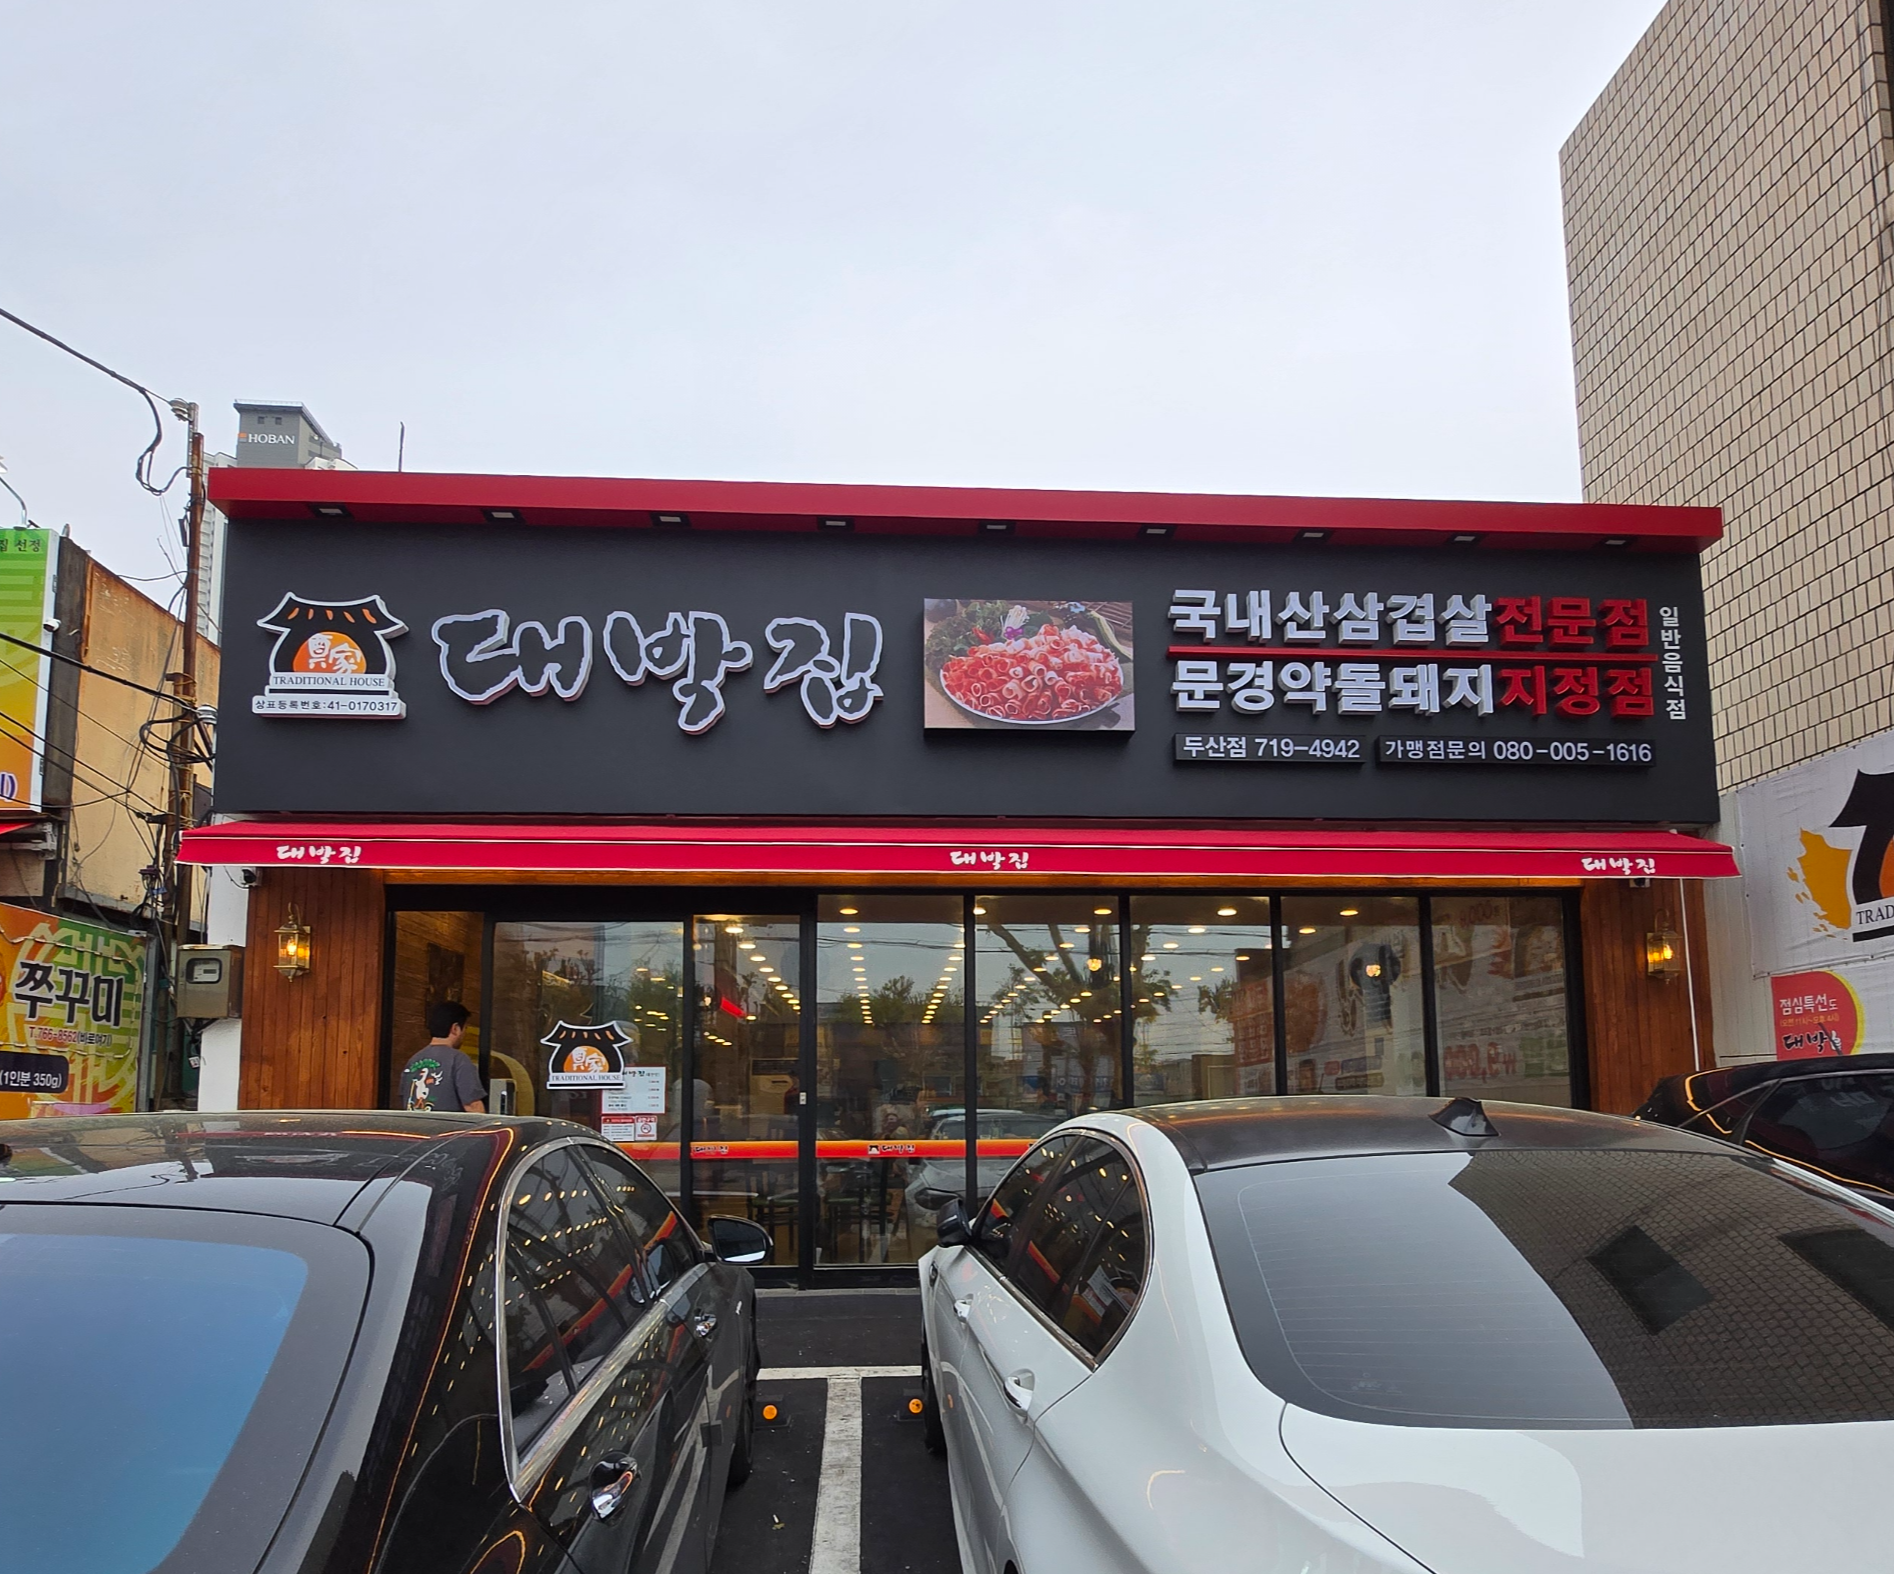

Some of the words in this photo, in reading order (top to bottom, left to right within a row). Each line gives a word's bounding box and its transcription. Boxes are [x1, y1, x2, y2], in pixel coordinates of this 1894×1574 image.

[248, 433, 295, 445] HOBAN
[15, 538, 41, 553] 선정
[431, 608, 884, 735] 대박집
[1659, 606, 1687, 720] 일반음식점
[273, 676, 347, 686] TRADITIONAL
[350, 677, 385, 687] HOUSE
[255, 700, 398, 711] 상표등록번호:41-0170317
[1183, 736, 1247, 758] 두산점
[1254, 738, 1361, 758] 719-4942
[1385, 740, 1486, 760] 가맹점문의
[1493, 741, 1652, 762] 080-005-1616
[276, 845, 362, 865] 대박집
[950, 851, 1029, 870] 대박집
[1581, 857, 1656, 875] 대박집
[1856, 904, 1894, 925] TRAD
[13, 960, 124, 1029] 쭈꾸미
[33, 1073, 62, 1089] 350g)
